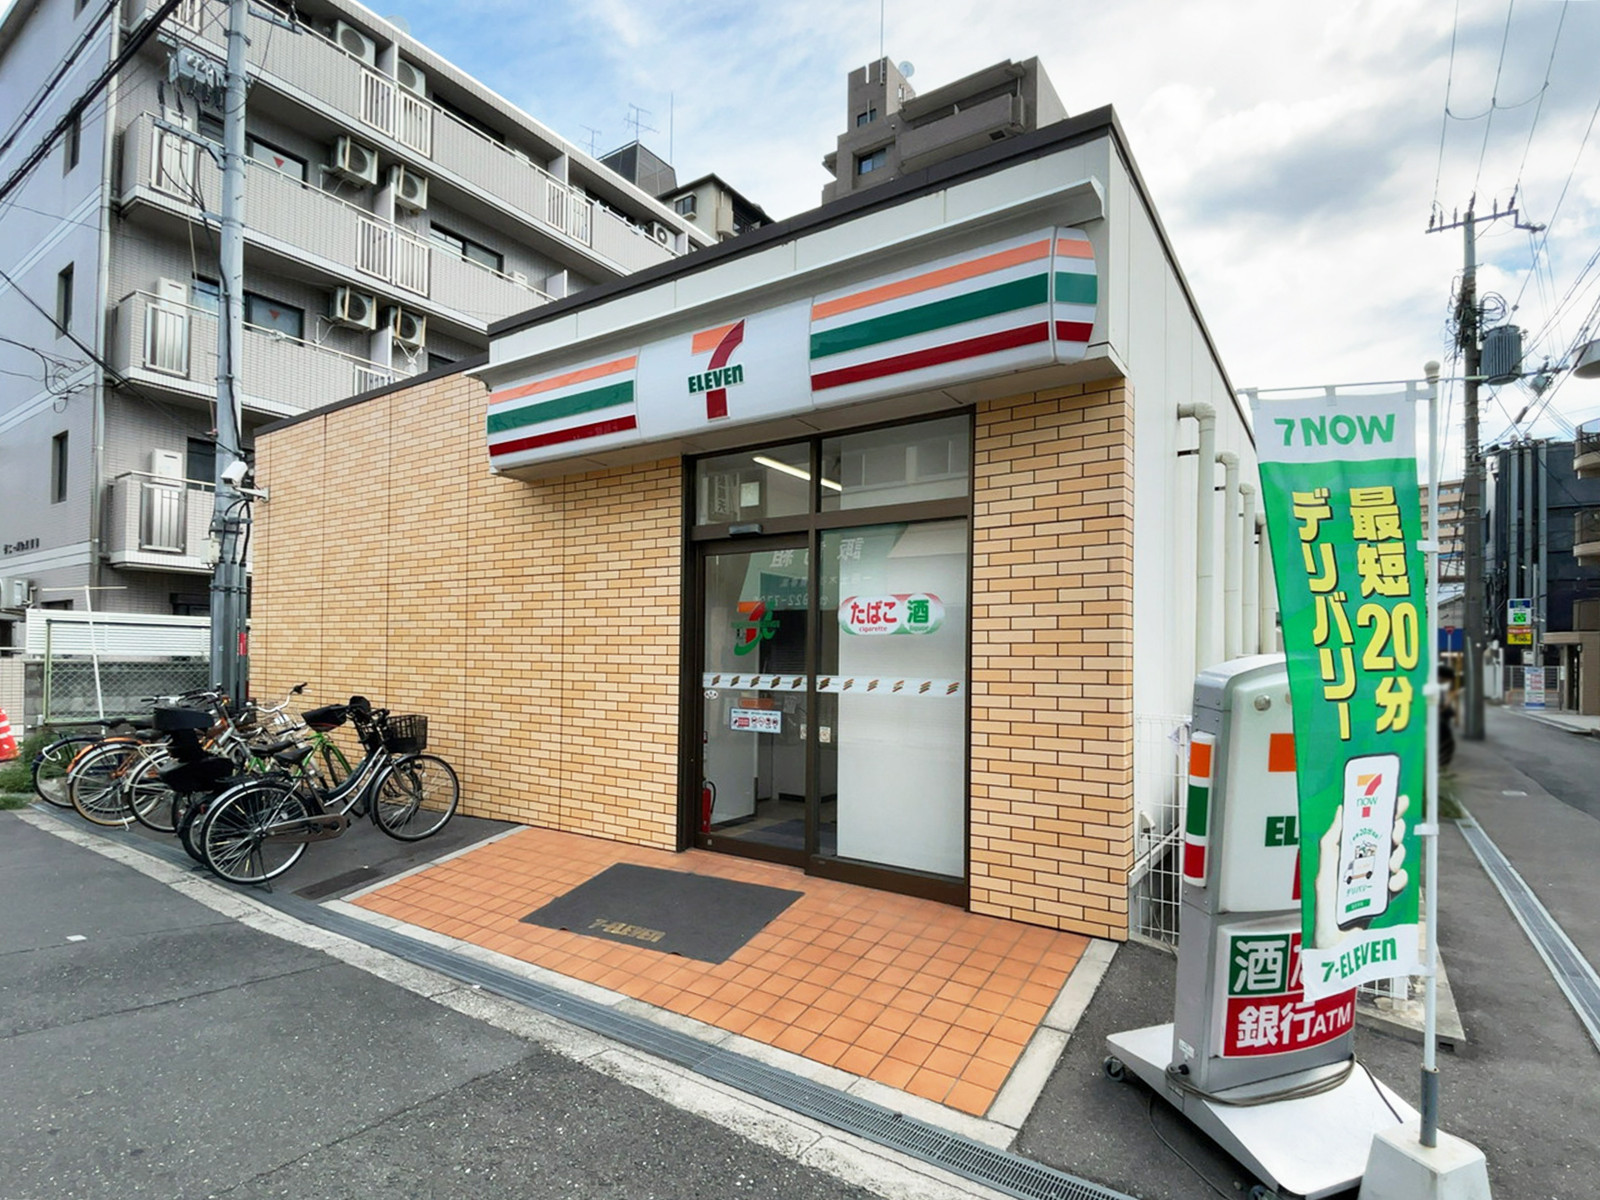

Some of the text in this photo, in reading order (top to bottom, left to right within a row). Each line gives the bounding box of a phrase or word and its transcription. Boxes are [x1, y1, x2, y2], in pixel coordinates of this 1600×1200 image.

[850, 600, 929, 624] たばこ 酒
[1292, 488, 1356, 740] デリバリー
[1350, 486, 1419, 733] 最短20分
[1357, 797, 1378, 807] now
[1235, 940, 1286, 993] 酒
